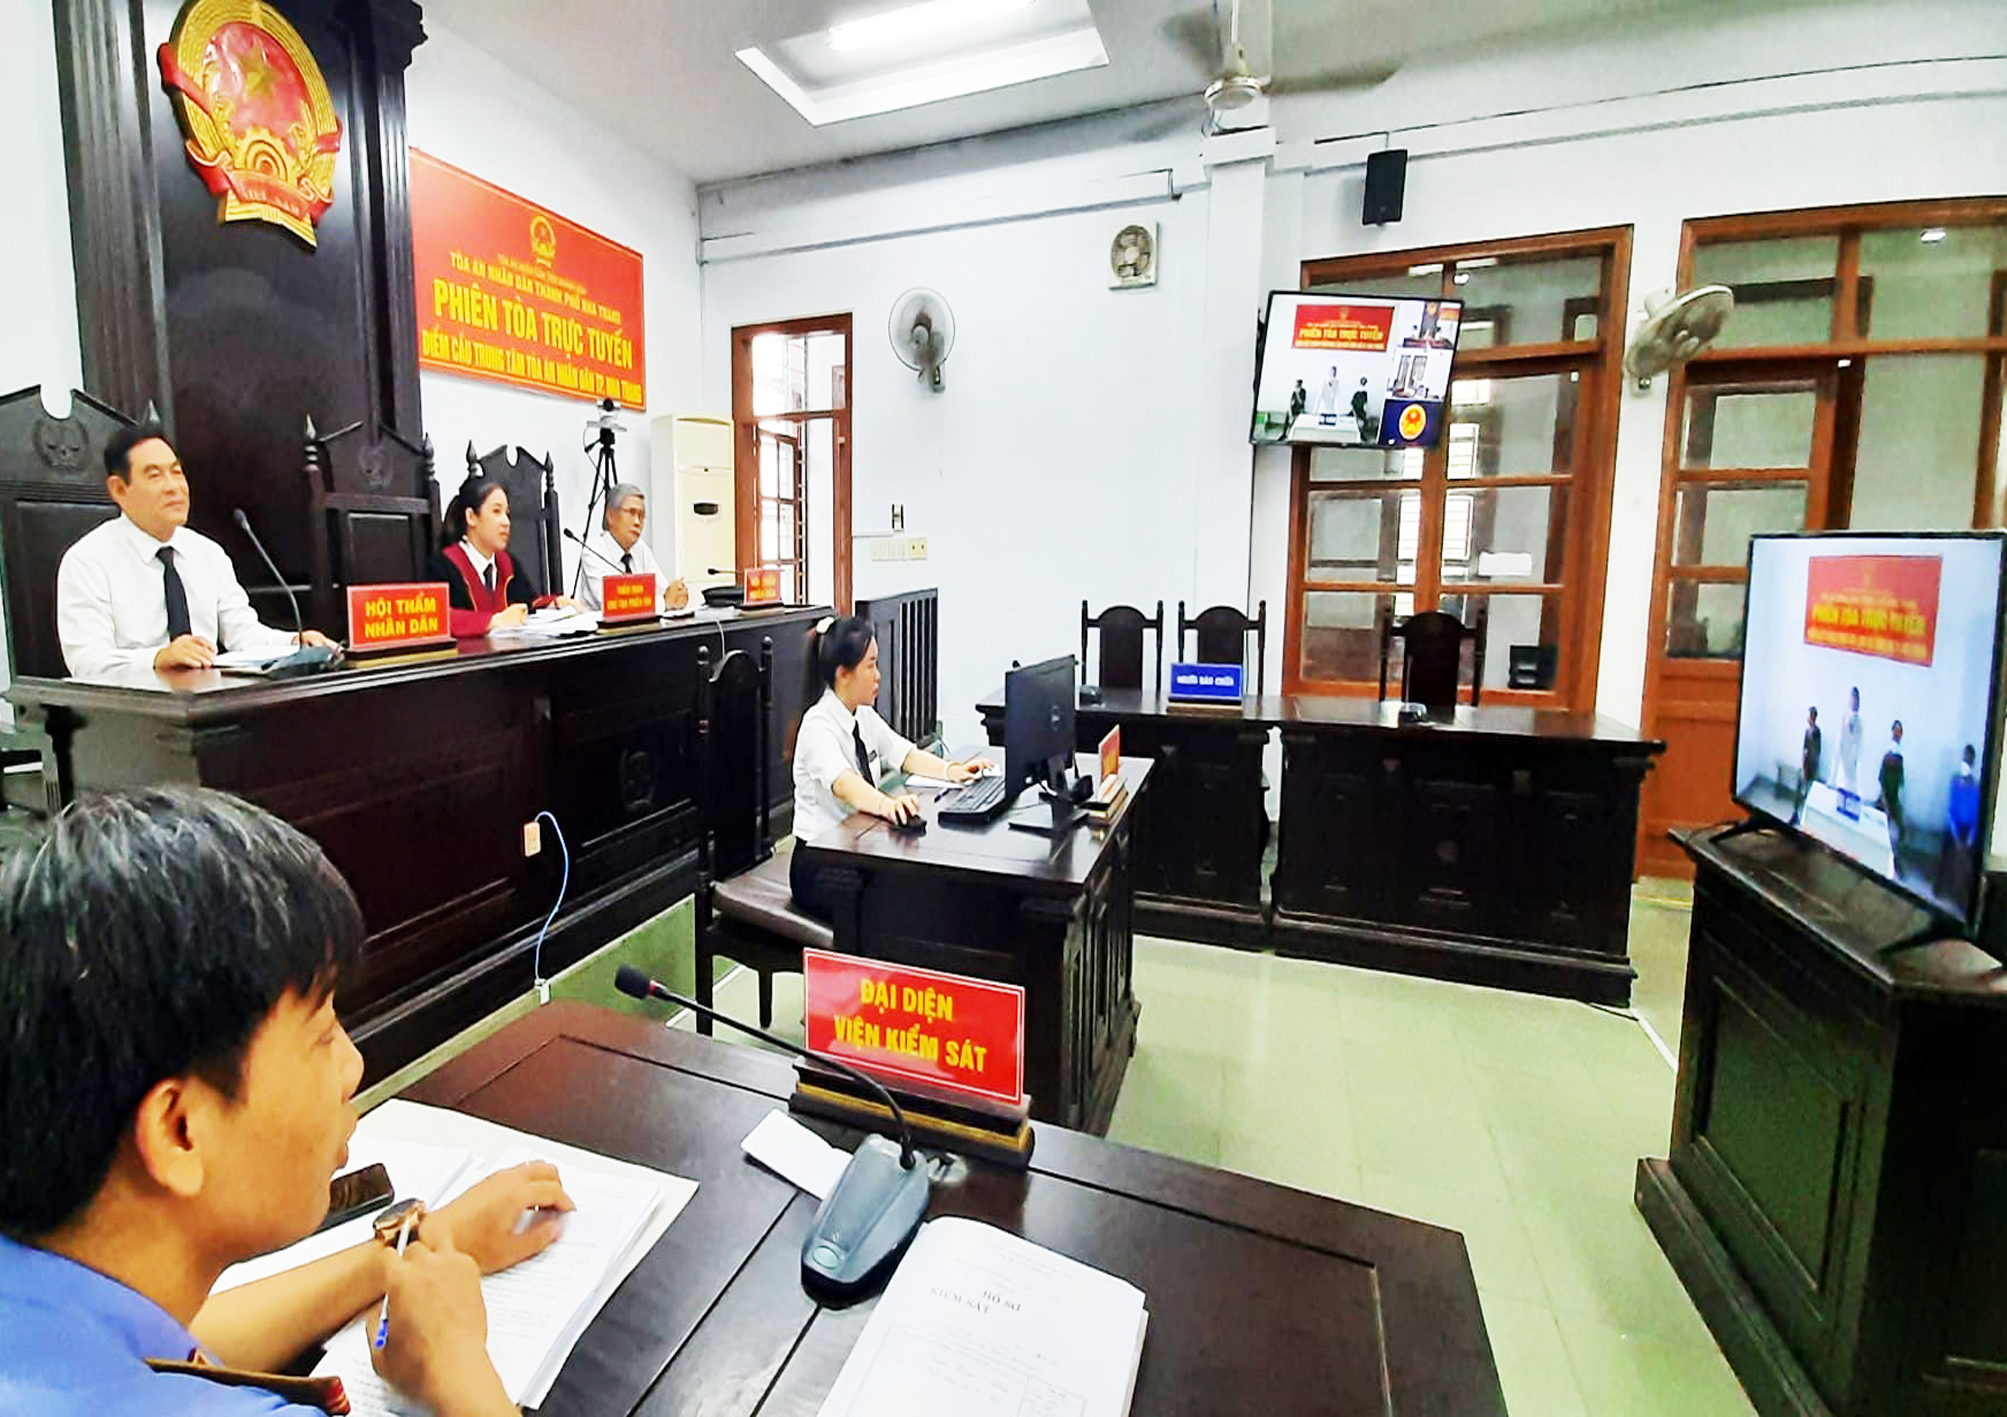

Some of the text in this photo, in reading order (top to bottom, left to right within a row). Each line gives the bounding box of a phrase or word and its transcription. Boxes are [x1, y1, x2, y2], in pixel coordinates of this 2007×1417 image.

[433, 277, 632, 370] PHIÊN TÒA TRỰC TUYẾN
[364, 614, 438, 637] NHÂN DÂN
[365, 591, 436, 618] HỘI THẨM
[860, 977, 953, 1024] ĐẠI DIỆN
[834, 1014, 987, 1072] VIỆN KIỂM SÁT
